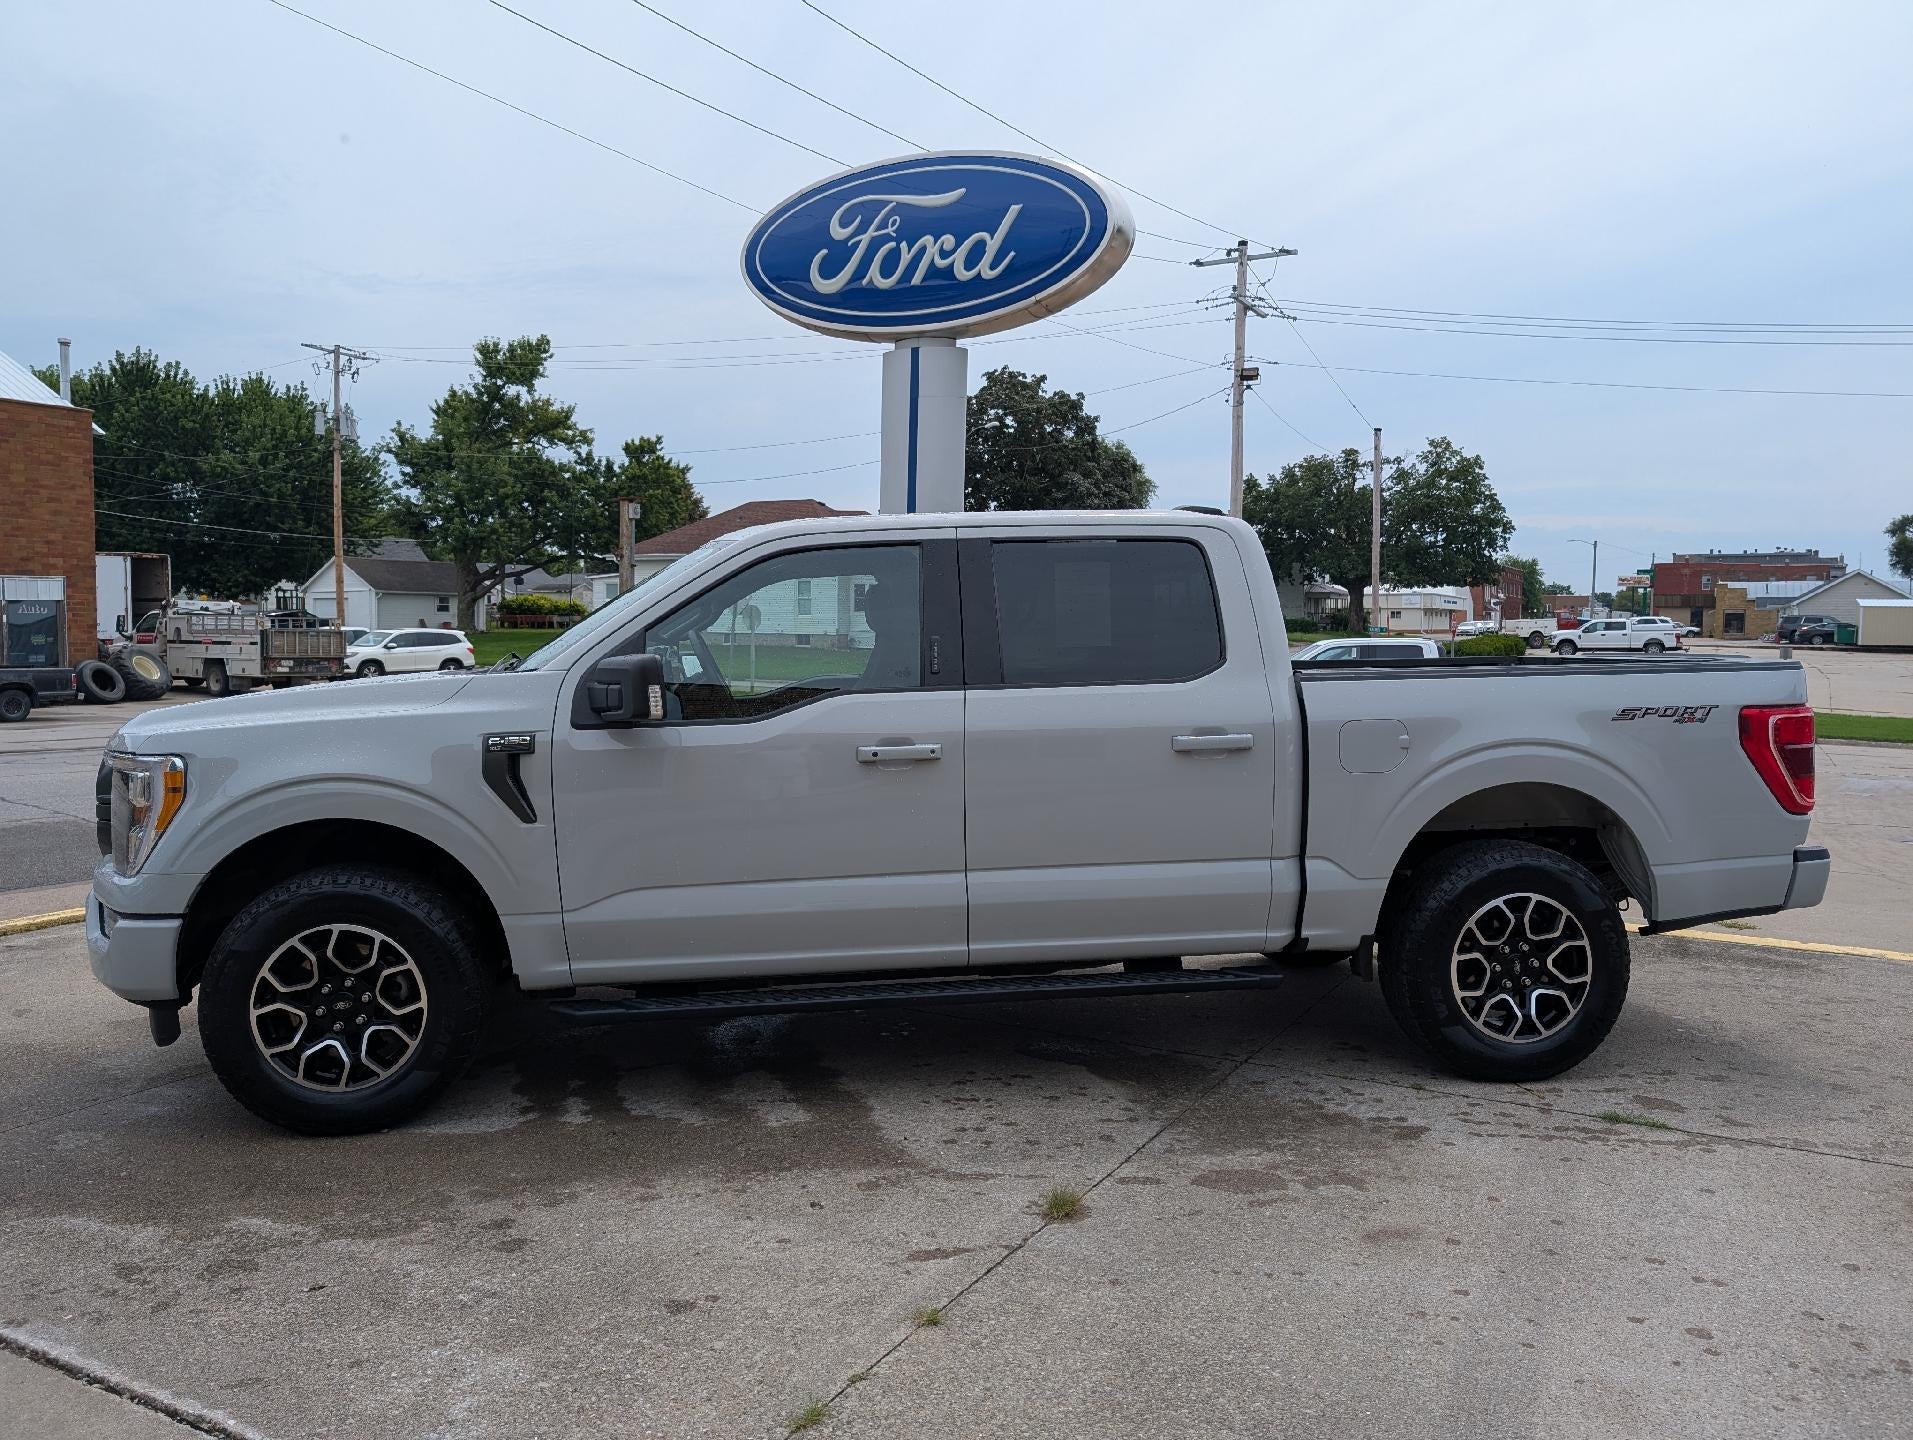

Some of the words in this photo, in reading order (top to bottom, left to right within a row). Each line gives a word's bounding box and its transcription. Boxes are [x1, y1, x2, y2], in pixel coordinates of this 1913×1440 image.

[810, 187, 1024, 294] Ford
[17, 603, 48, 614] Auto
[1611, 704, 1720, 721] SPORT
[488, 736, 531, 745] F-150
